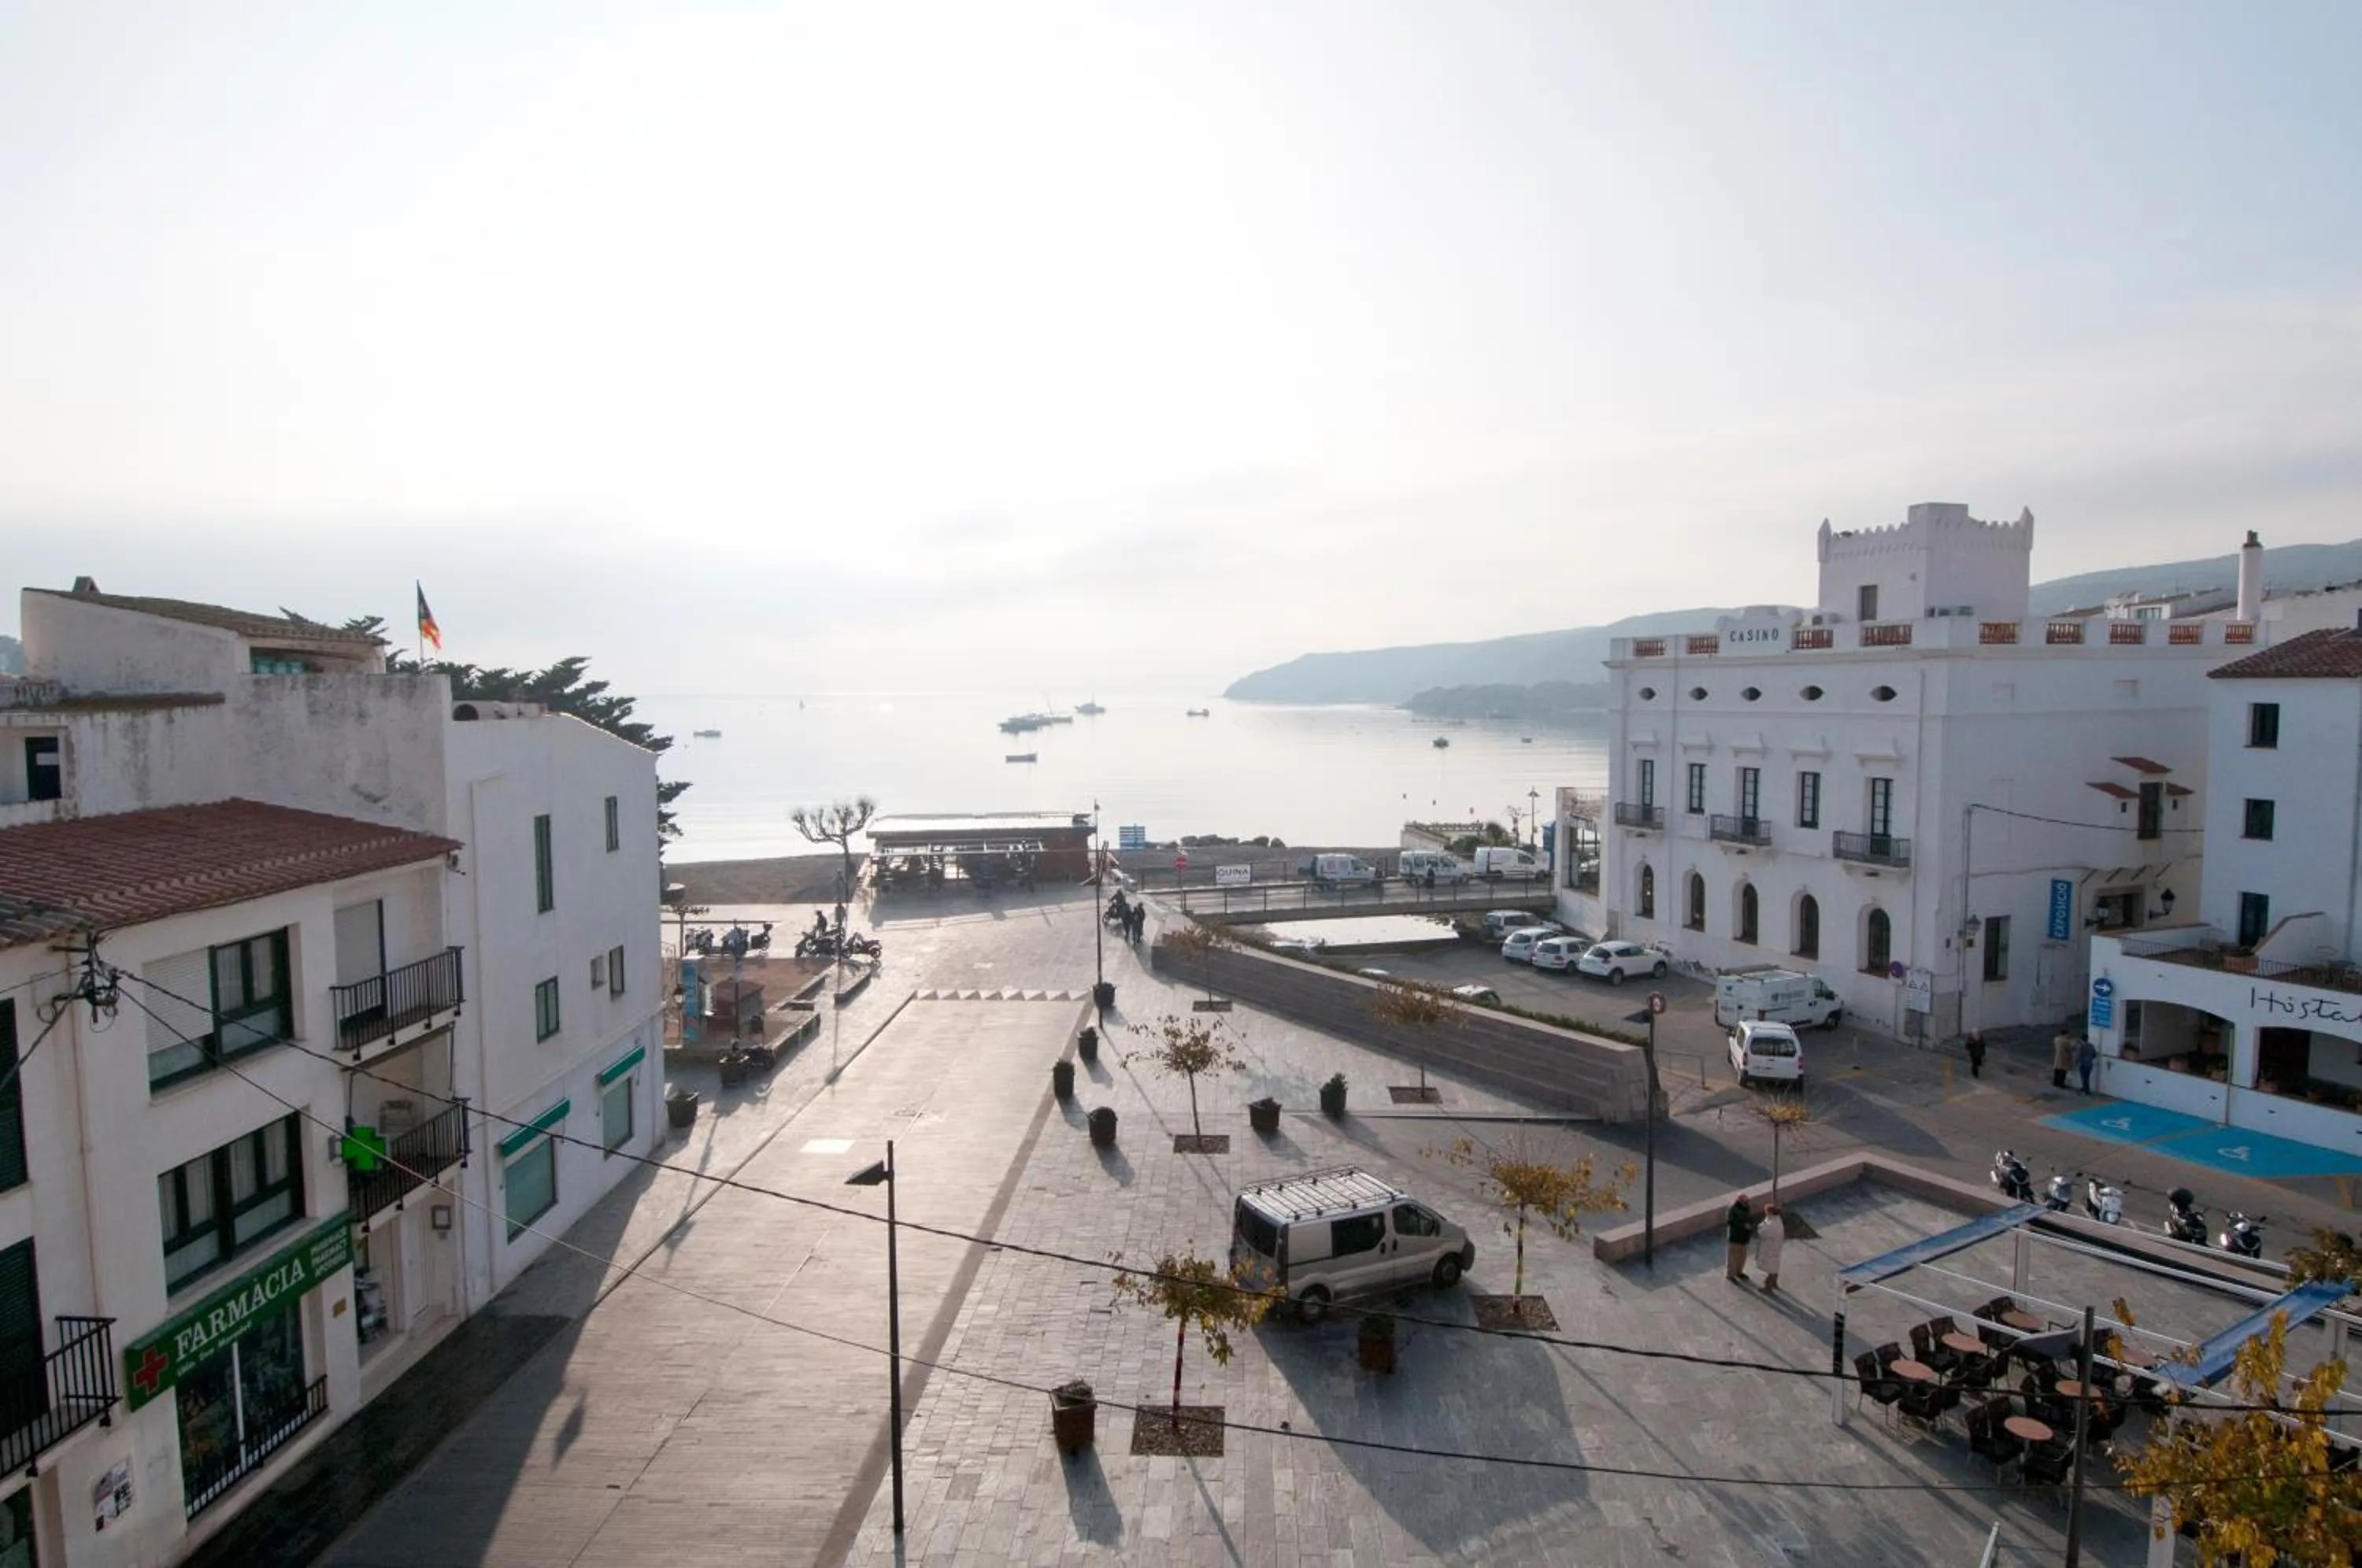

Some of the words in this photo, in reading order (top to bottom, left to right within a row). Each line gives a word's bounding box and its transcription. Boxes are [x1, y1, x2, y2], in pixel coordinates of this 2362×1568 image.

[1730, 627, 1779, 643] CASINO
[2053, 882, 2068, 937] EXPOSICIÓ
[174, 1257, 305, 1363] FARMÀCIA
